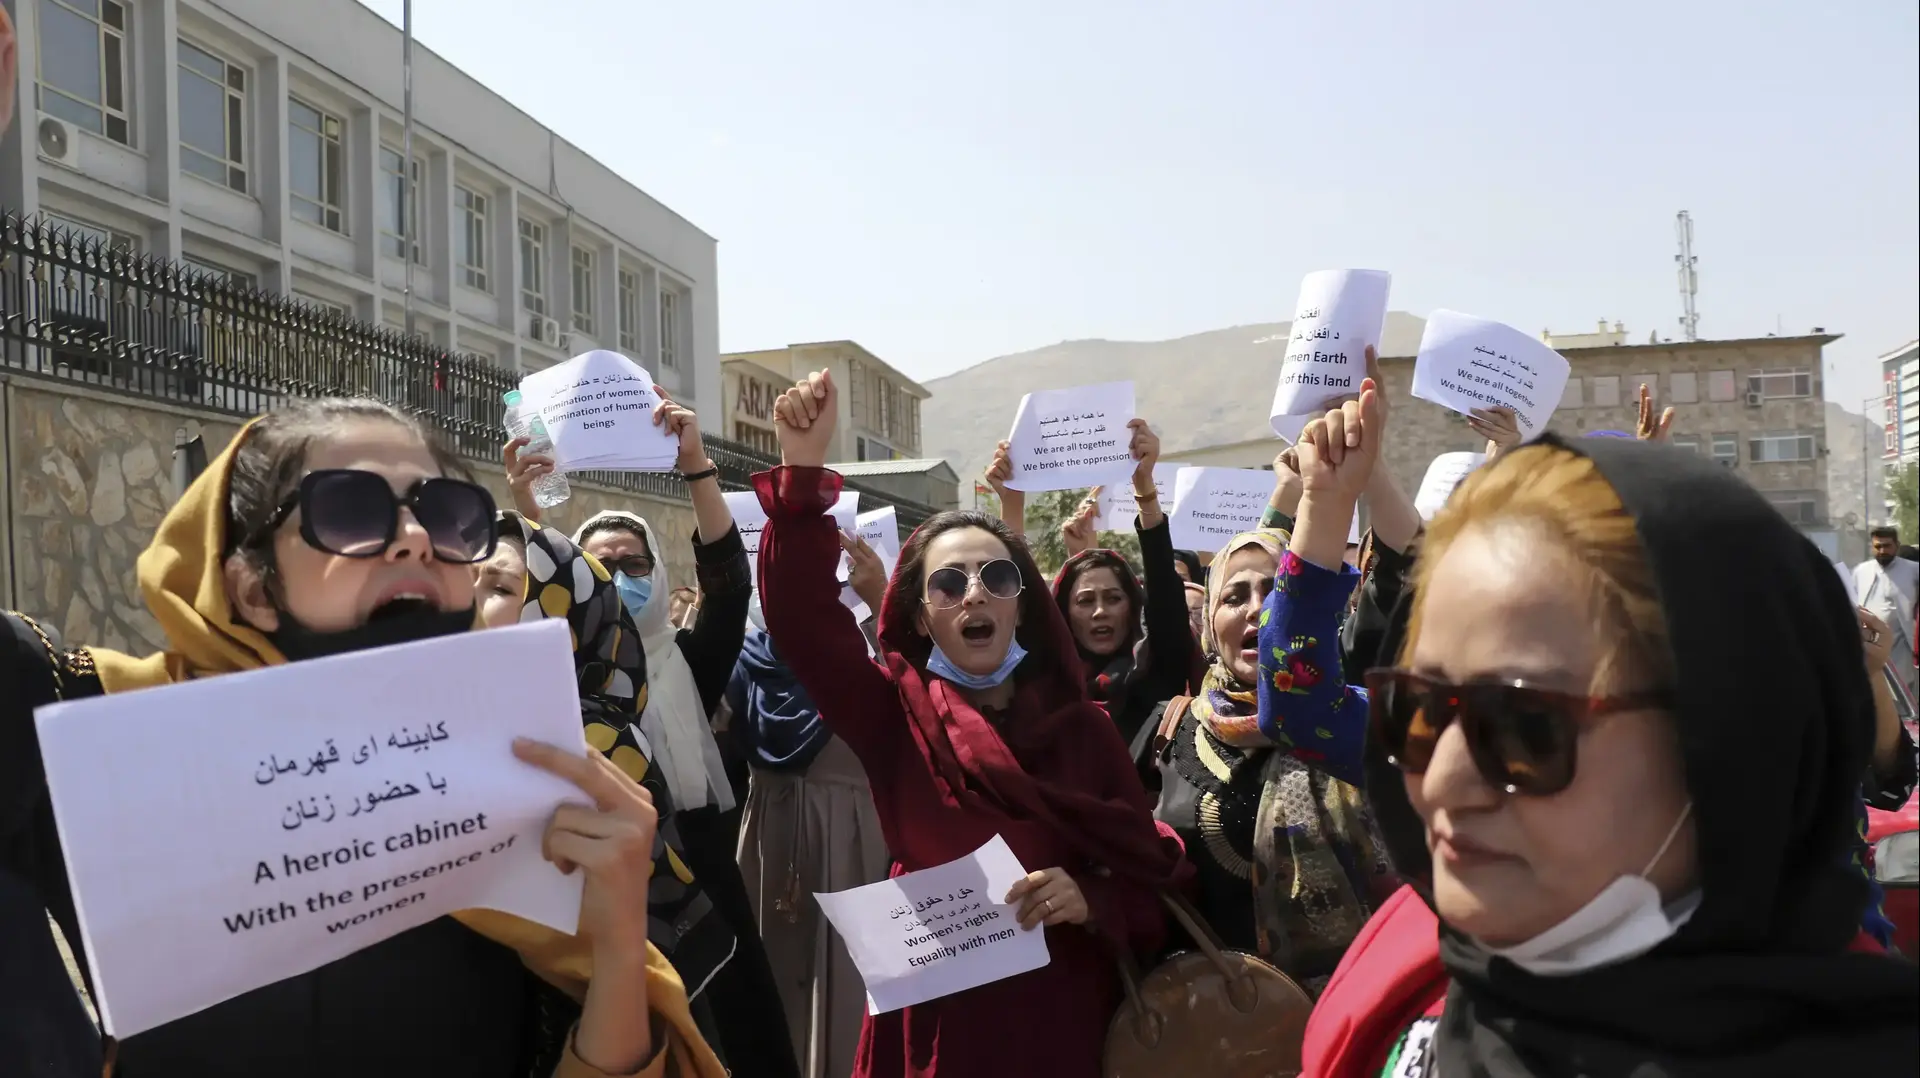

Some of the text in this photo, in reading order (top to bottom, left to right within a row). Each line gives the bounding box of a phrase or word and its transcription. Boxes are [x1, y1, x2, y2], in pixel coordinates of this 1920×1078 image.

[1306, 328, 1330, 342] افغان
[1314, 351, 1347, 364] Earth
[572, 378, 590, 388] حذف
[602, 374, 621, 384] زنان
[1298, 372, 1320, 385] this
[1324, 374, 1351, 388] land
[1457, 368, 1536, 409] We are all together
[542, 394, 594, 414] Elimination
[596, 390, 606, 400] of
[608, 388, 646, 398] women
[1440, 378, 1456, 391] We
[1456, 386, 1484, 400] broke
[1486, 396, 1502, 406] the
[548, 402, 650, 425] elimination of human
[583, 418, 616, 430] beings
[1034, 447, 1049, 455] We
[1066, 444, 1077, 452] all
[1079, 440, 1116, 452] together
[1023, 452, 1130, 472] We broke the oppression
[1192, 510, 1228, 521] Freedom
[1230, 513, 1237, 521] is
[1240, 514, 1253, 522] our
[1207, 526, 1234, 534] makes
[254, 720, 450, 784] کابینه ای قهرمان
[280, 771, 447, 831] با حضور زنان
[253, 811, 488, 885] A heroic cabinet
[222, 832, 518, 935] With the presence of
[325, 891, 426, 935] women
[890, 888, 974, 919] حق و حقوق زنان
[904, 917, 932, 932] مردان
[904, 910, 1000, 948] Women's rights
[908, 926, 1016, 967] Equality with men
